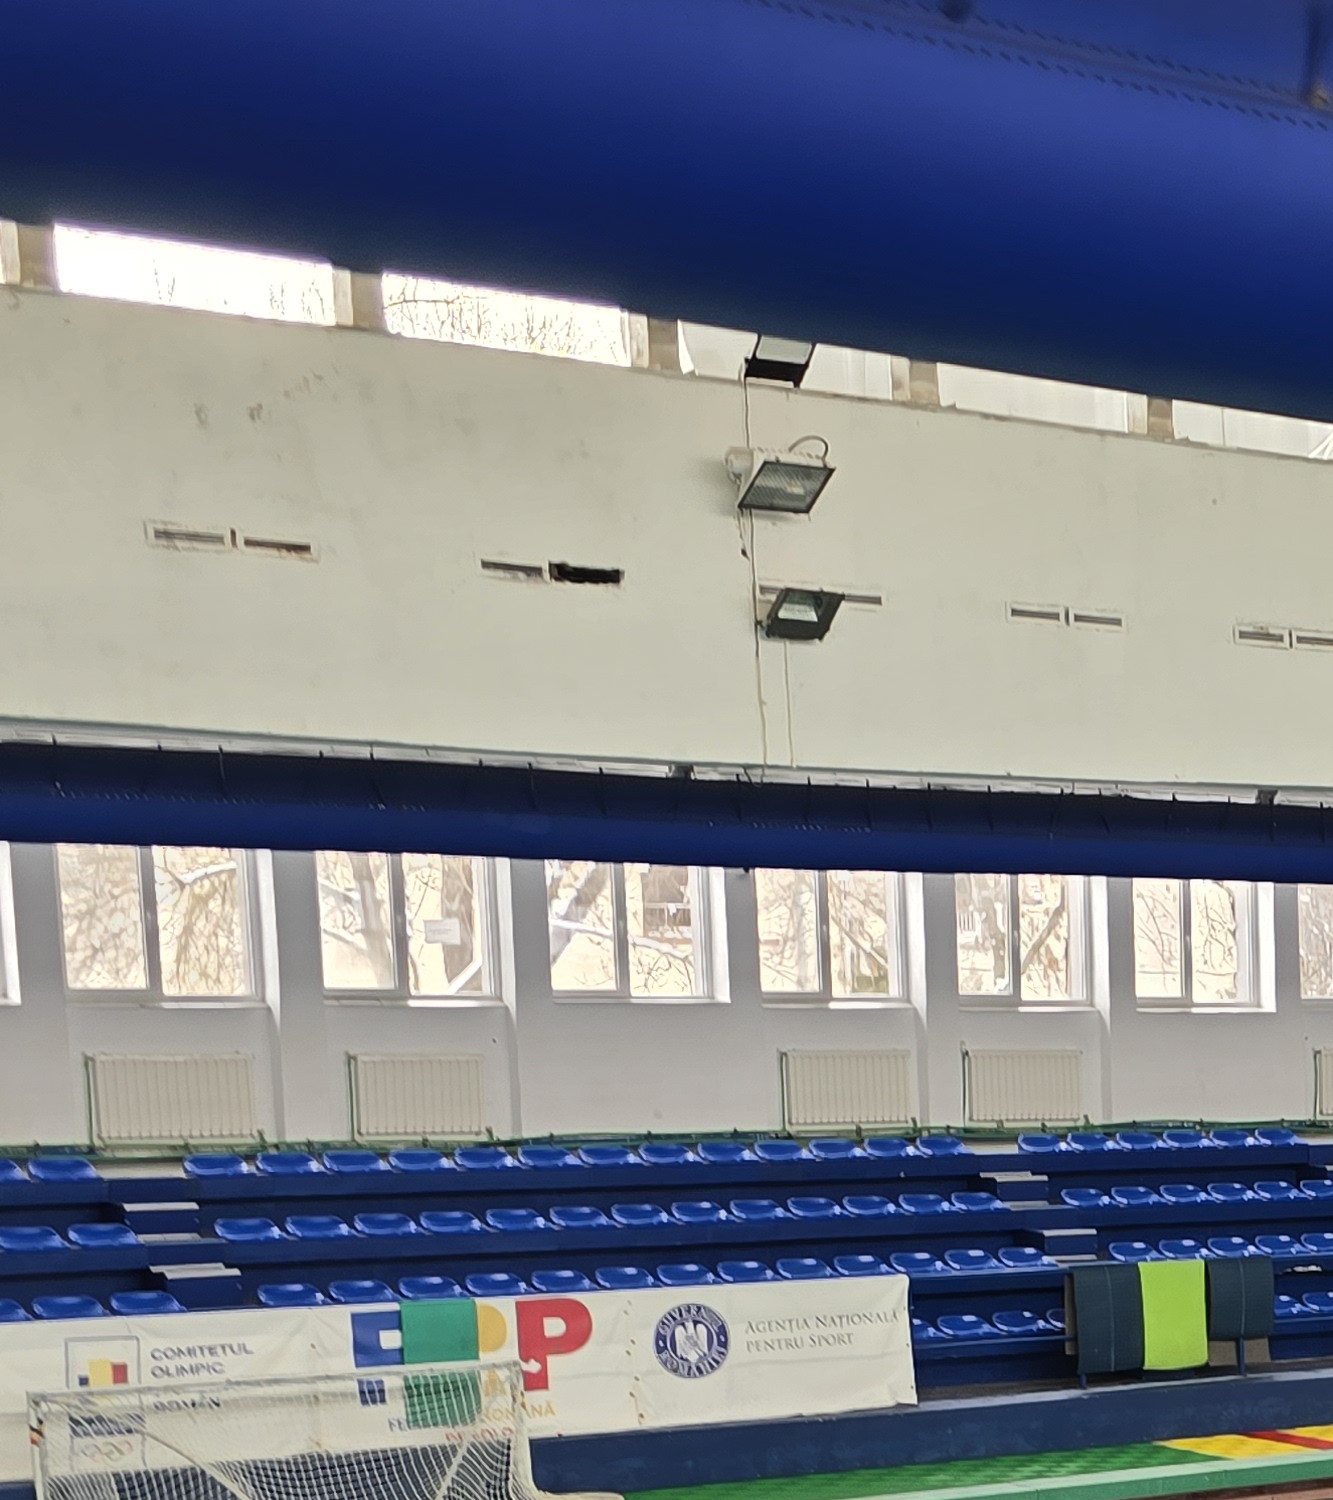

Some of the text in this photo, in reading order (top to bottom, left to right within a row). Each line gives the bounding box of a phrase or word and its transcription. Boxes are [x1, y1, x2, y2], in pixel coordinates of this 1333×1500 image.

[150, 1342, 255, 1362] COMITETUL
[746, 1332, 855, 1353] PENTRU SPORT
[150, 1362, 227, 1379] OLIMPIC
